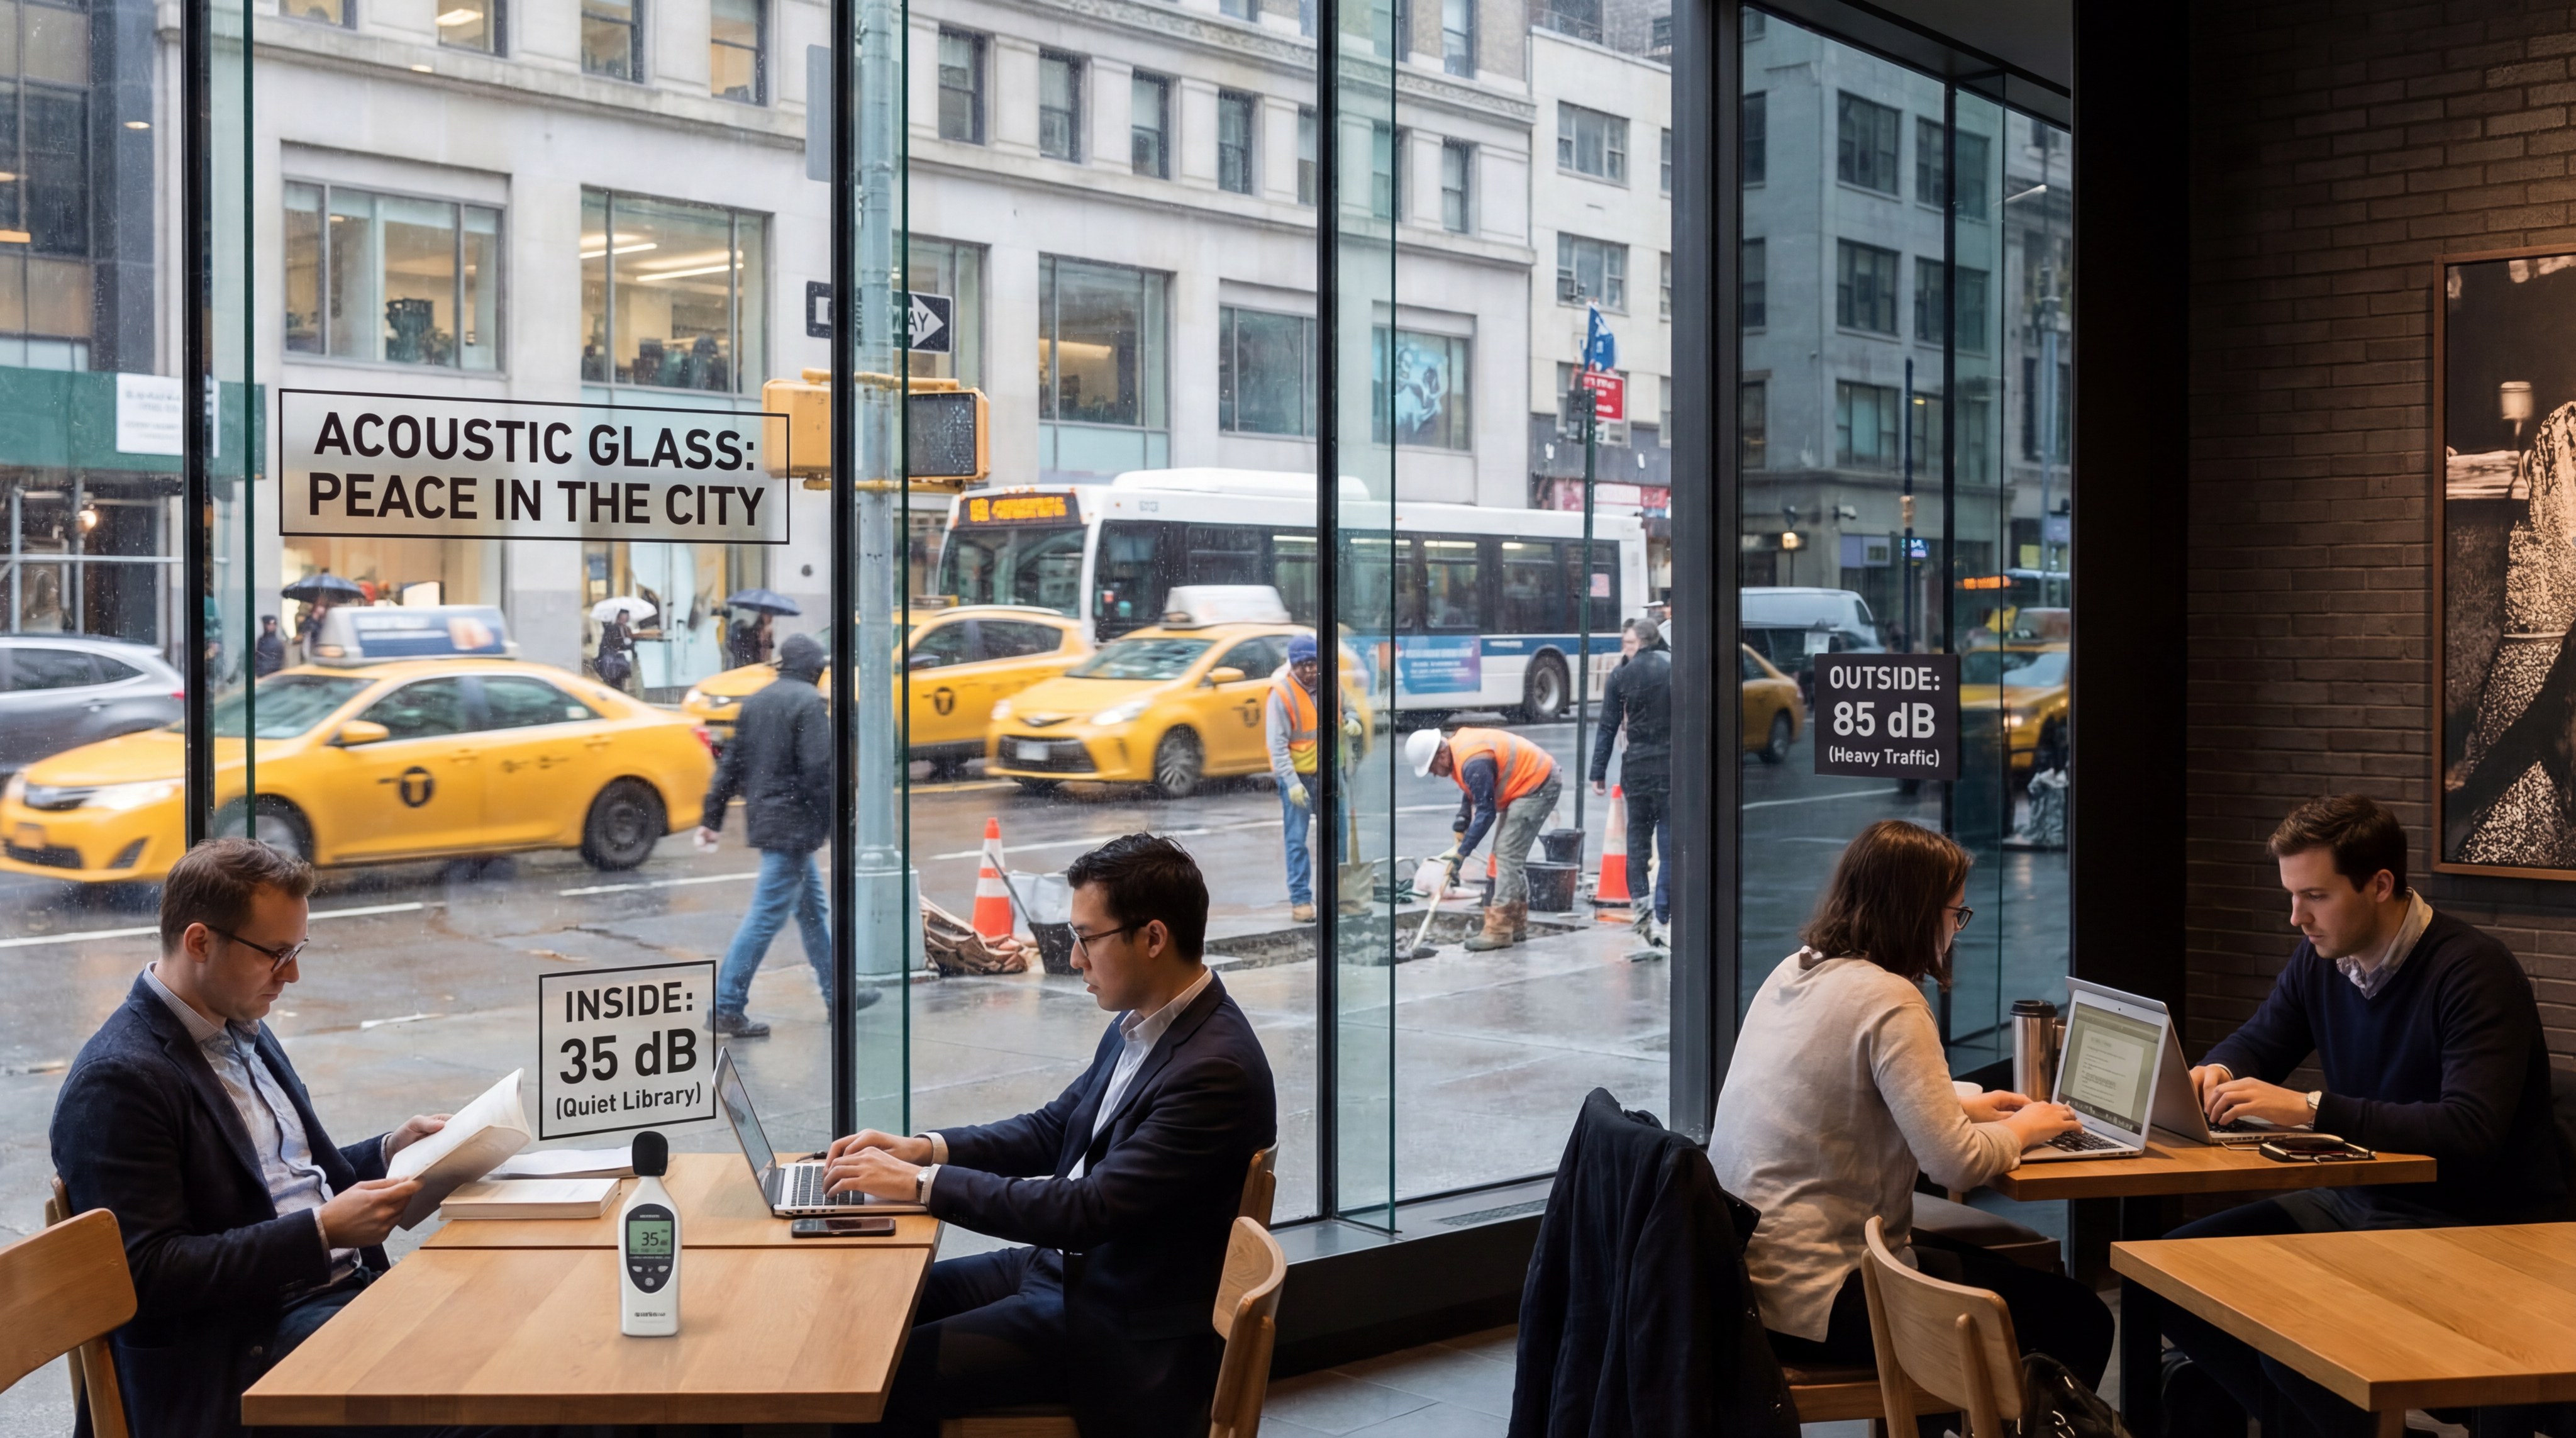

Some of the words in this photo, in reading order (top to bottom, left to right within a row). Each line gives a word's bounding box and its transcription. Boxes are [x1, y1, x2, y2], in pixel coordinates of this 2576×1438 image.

[314, 412, 572, 464] ACOUSTIC
[589, 425, 753, 471] GLASS:
[310, 472, 477, 519] PEACE
[496, 479, 540, 520] IN
[558, 481, 650, 523] THE
[666, 484, 765, 526] CITY
[1829, 666, 1940, 691] OUTSIDE:
[1833, 701, 1875, 737] 85
[1888, 703, 1935, 738] dB
[1829, 746, 1880, 767] (Heavy
[1884, 749, 1940, 767] Traffic)
[566, 981, 692, 1023] INSIDE:
[560, 1035, 618, 1084] 35
[635, 1028, 697, 1077] dB
[557, 1094, 616, 1120] (Quiet
[623, 1081, 701, 1110] Library)
[641, 1232, 658, 1246] 35
